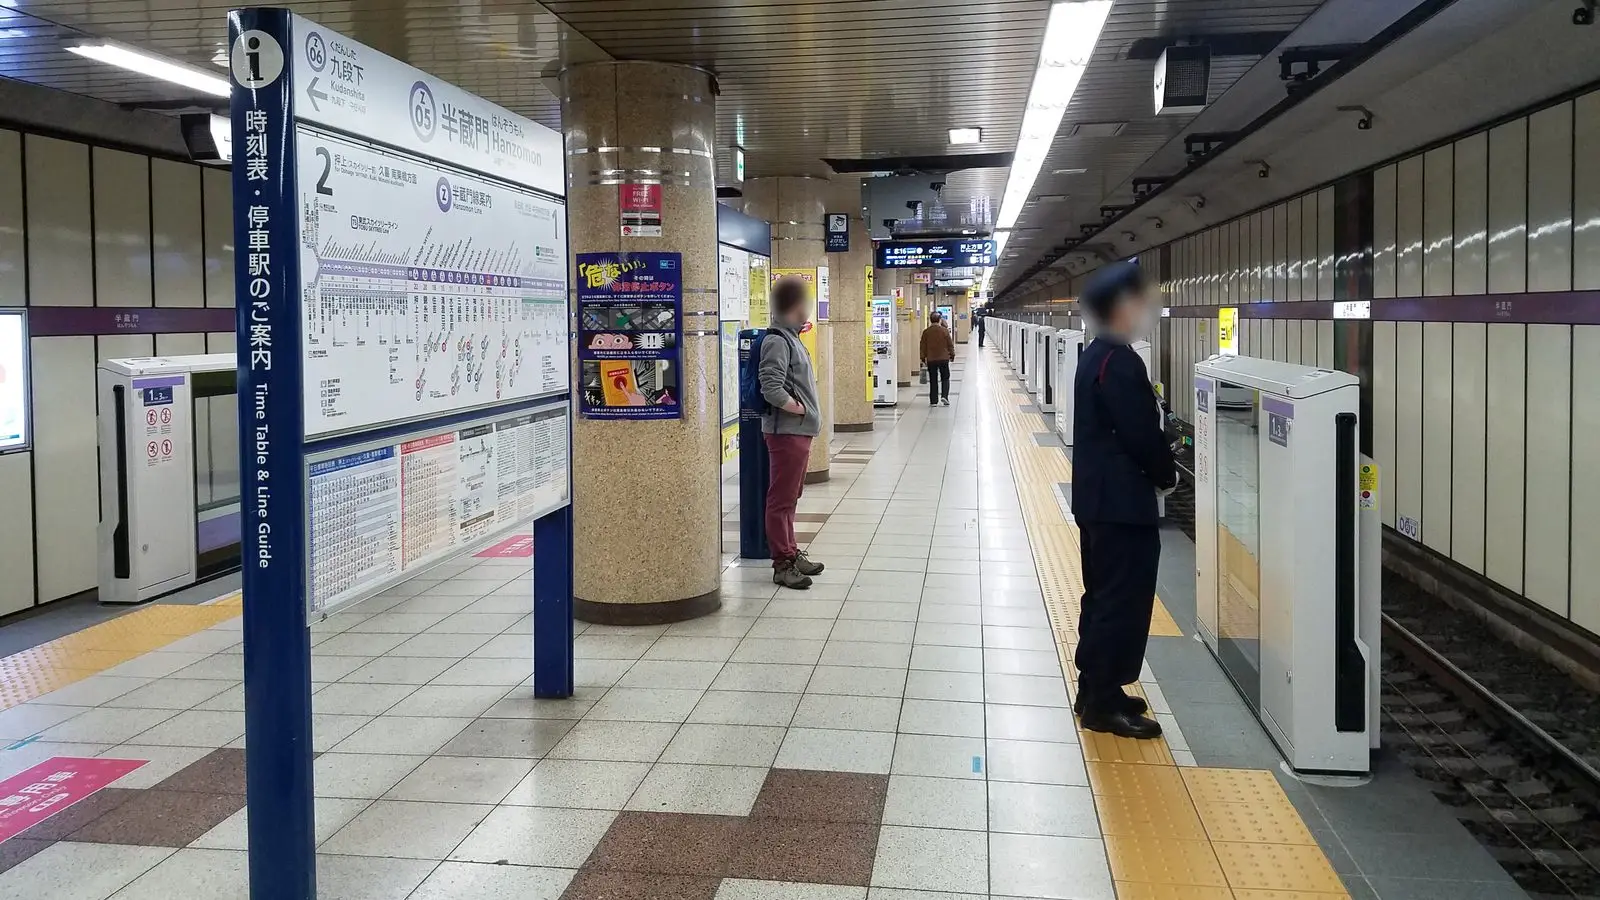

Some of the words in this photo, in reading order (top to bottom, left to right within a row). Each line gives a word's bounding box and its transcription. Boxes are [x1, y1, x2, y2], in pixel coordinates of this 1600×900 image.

[310, 47, 323, 64] 06
[313, 38, 318, 48] Z
[330, 41, 357, 60] くだんした
[330, 56, 364, 86] 九段下
[330, 80, 366, 102] Kudanshita
[420, 90, 426, 105] Z
[415, 104, 432, 131] 05
[441, 103, 490, 155] 半蔵門
[492, 129, 542, 167] Hanzomon
[315, 146, 333, 196] 2
[442, 188, 447, 201] Z
[452, 184, 492, 209] 半蔵門線案内
[245, 109, 271, 372] 時刻表・停車駅のご案内
[983, 242, 992, 254] 2
[149, 389, 154, 401] 1
[158, 392, 163, 401] 3
[255, 383, 268, 420] Time
[256, 424, 270, 465] Table
[257, 469, 270, 481] &
[257, 486, 271, 518] Line
[258, 522, 272, 568] Guide
